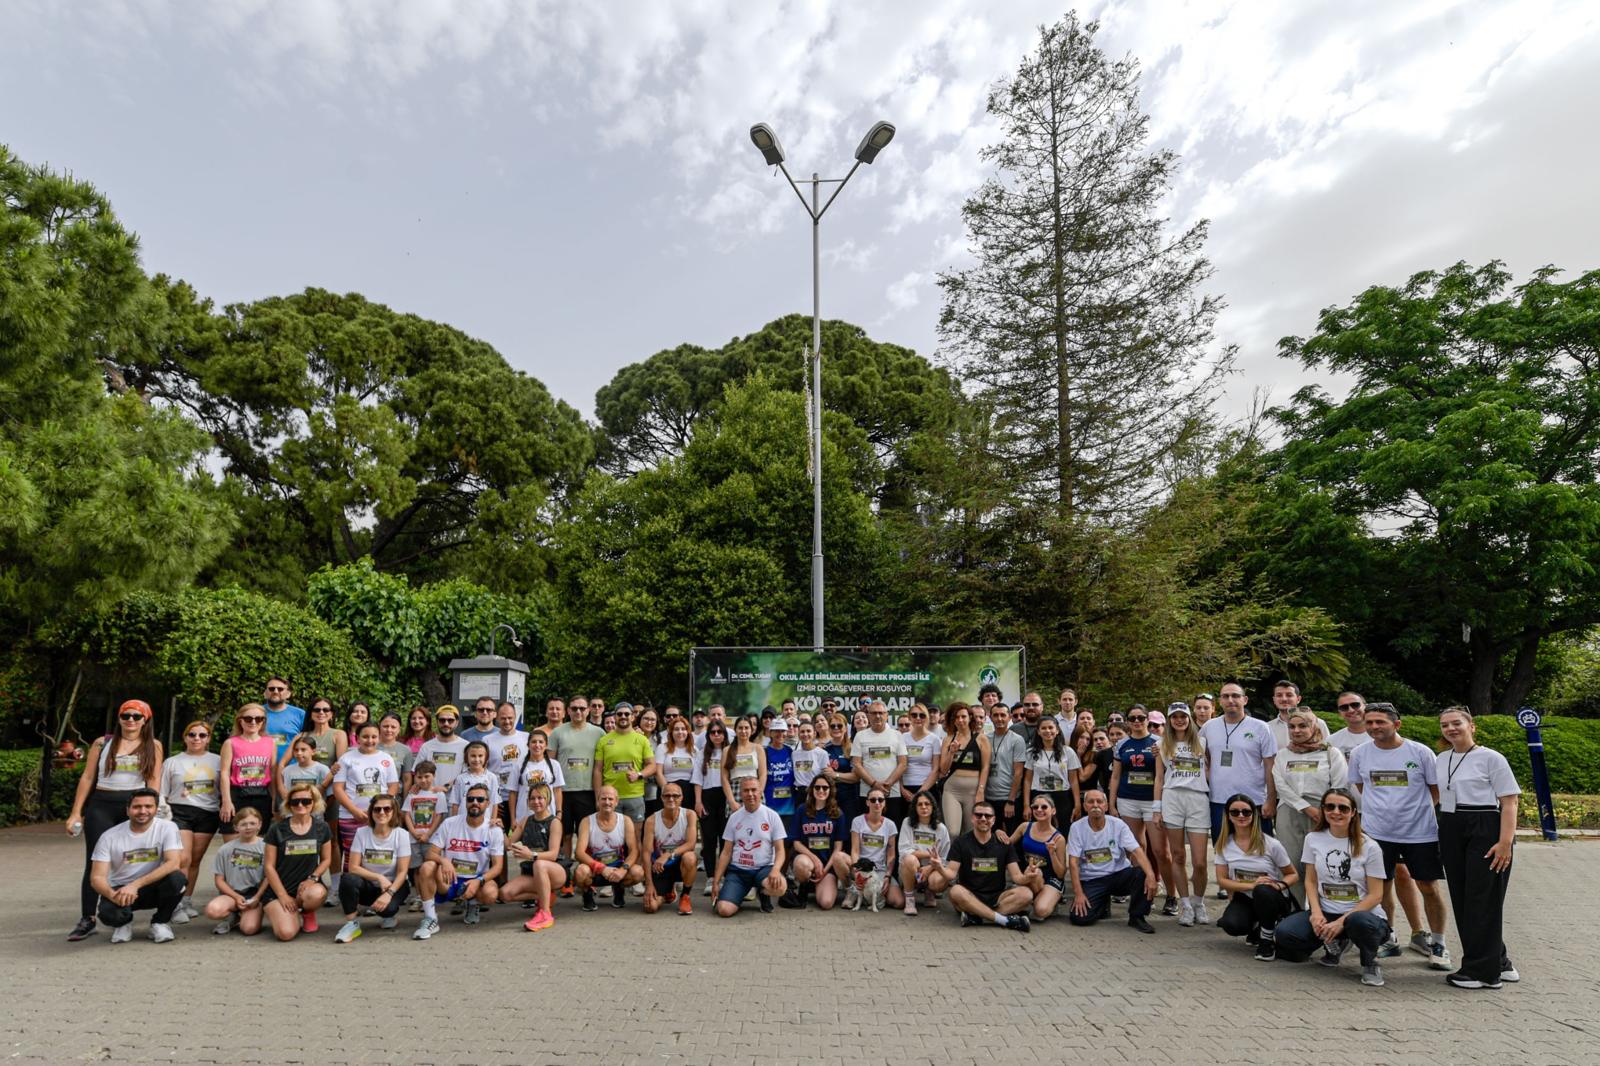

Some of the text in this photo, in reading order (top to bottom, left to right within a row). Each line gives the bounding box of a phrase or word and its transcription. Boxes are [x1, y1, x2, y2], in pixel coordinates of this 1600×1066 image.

[799, 672, 814, 680] AİLE
[815, 672, 860, 680] BİRLİKLERİNE
[888, 672, 918, 680] PROJESİ
[919, 672, 930, 680] İLE
[796, 683, 912, 693] İZMİR DOĞASEVERLER KOŞUYOR
[833, 696, 915, 711] OKARI
[1129, 754, 1145, 767] 12
[802, 820, 833, 834] ODTÜ
